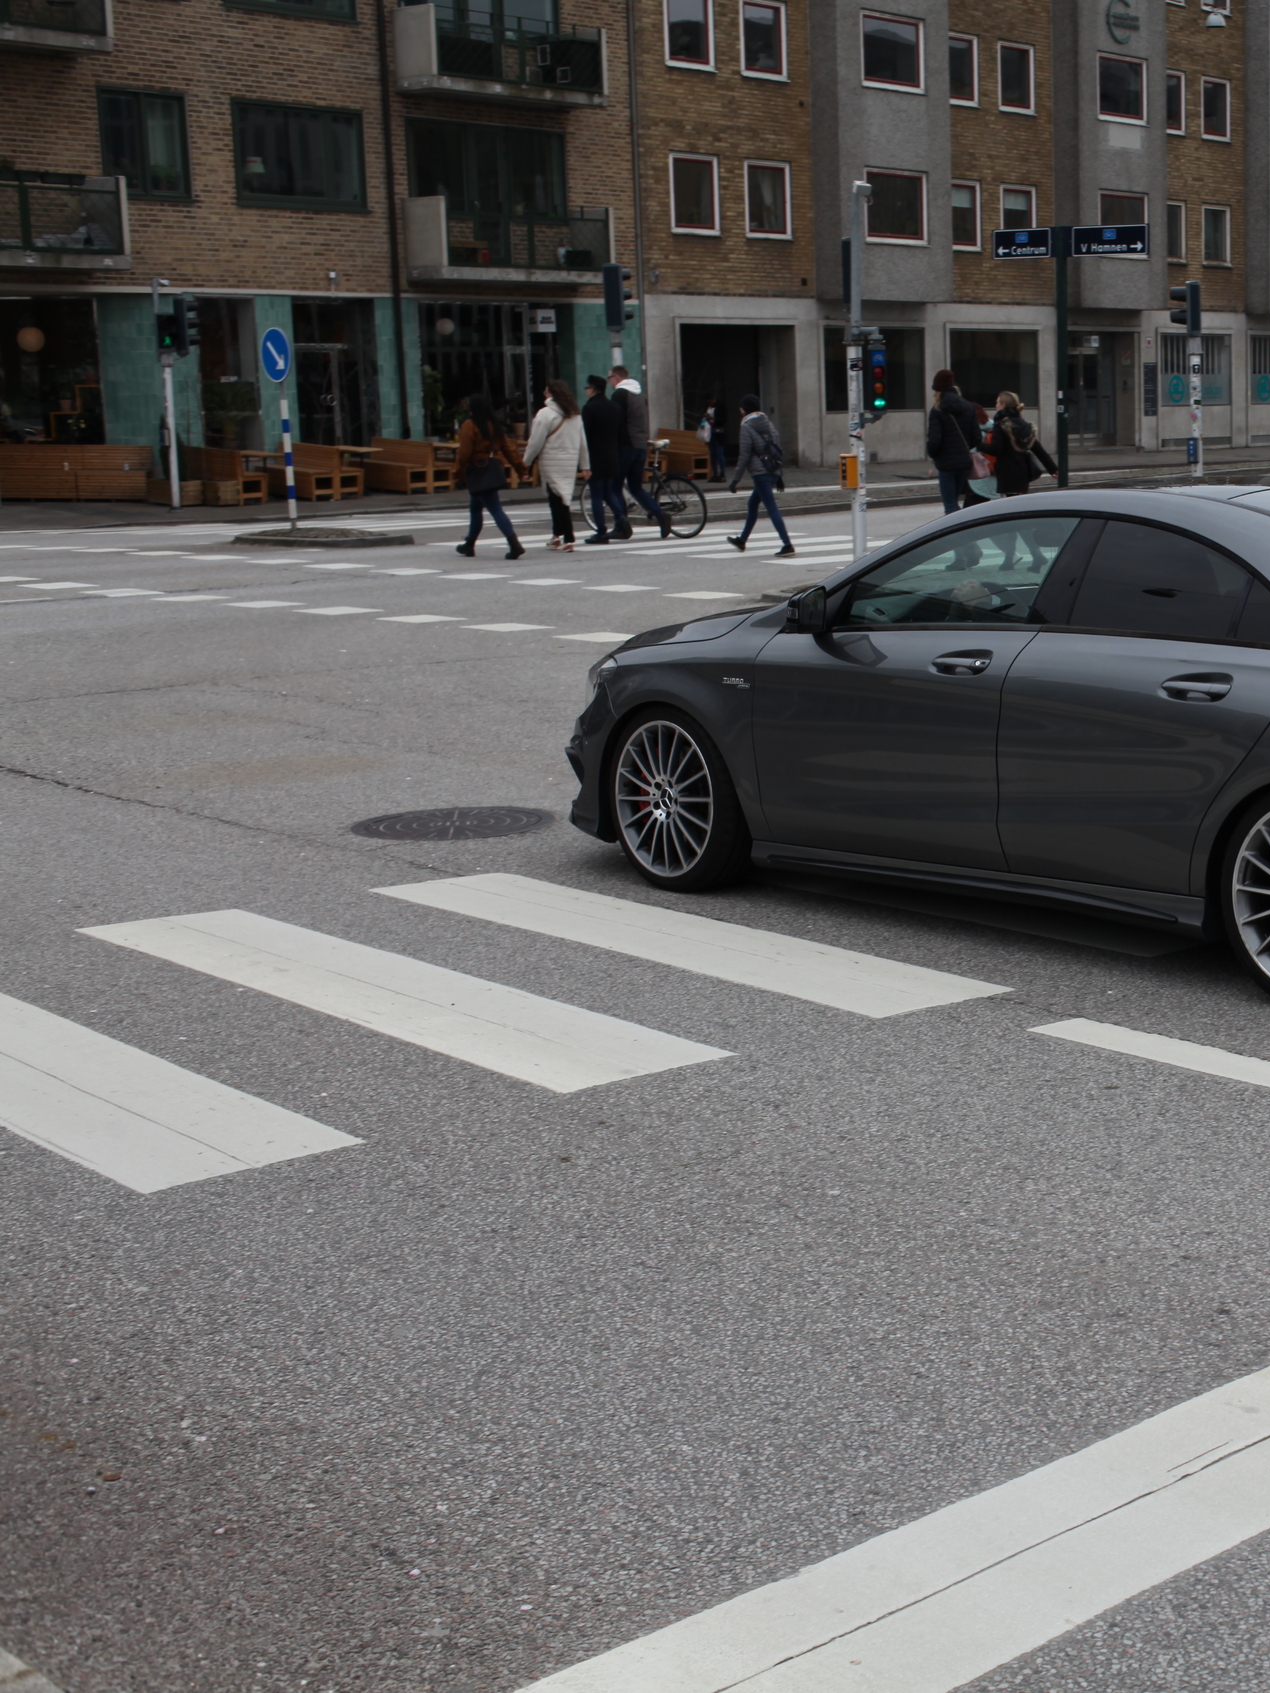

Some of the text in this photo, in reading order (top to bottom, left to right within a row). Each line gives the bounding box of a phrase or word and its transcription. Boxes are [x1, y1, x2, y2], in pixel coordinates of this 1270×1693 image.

[1011, 245, 1047, 255] Centrum
[1081, 243, 1127, 252] V Hamnen
